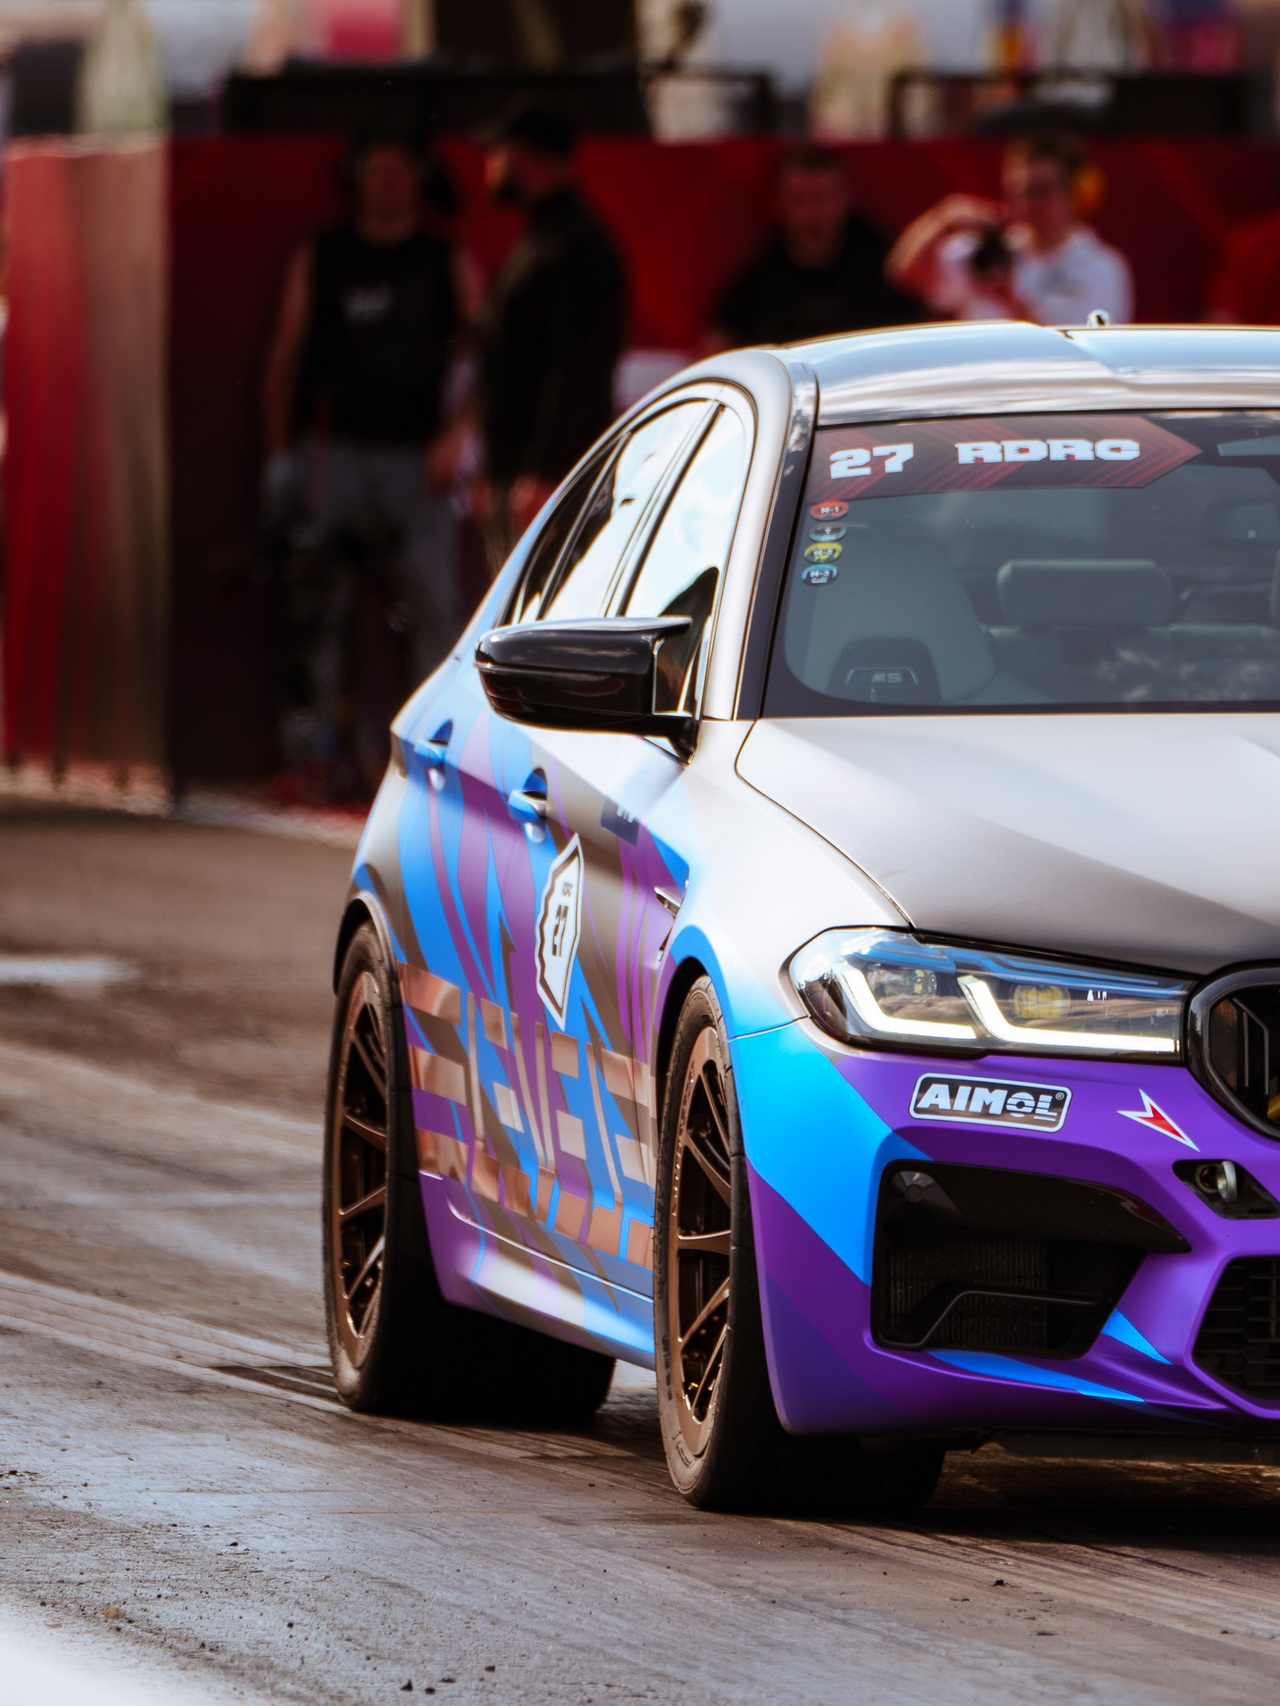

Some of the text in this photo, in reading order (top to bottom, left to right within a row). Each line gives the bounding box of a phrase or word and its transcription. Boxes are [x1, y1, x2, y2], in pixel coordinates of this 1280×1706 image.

[829, 439, 1141, 479] 27 RDRC
[871, 673, 902, 684] M5
